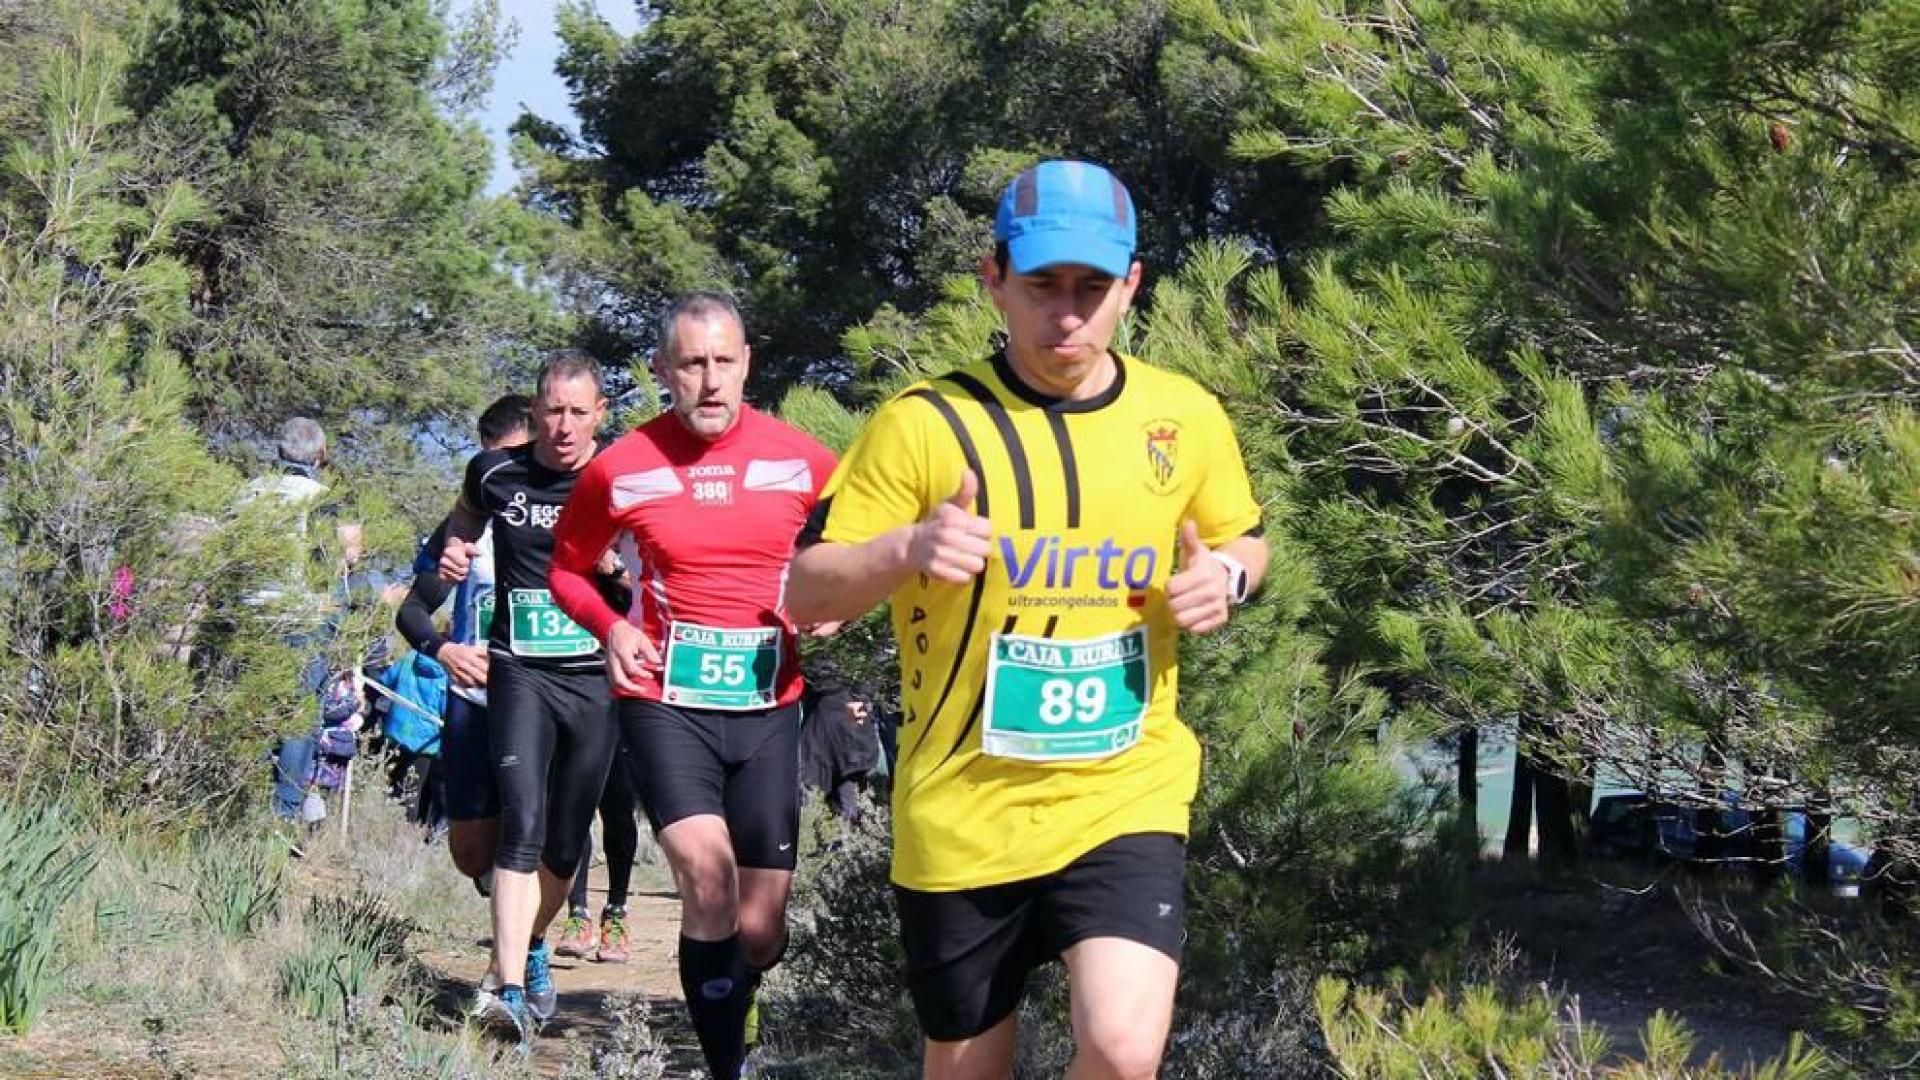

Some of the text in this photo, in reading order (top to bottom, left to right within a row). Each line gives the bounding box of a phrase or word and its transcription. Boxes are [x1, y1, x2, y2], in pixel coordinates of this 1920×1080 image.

[999, 536, 1157, 589] Virto
[1007, 594, 1119, 608] ultracongelados
[526, 610, 582, 637] 132
[1008, 637, 1139, 667] CAJA RURAL
[700, 653, 746, 686] 55
[1039, 677, 1107, 726] 89
